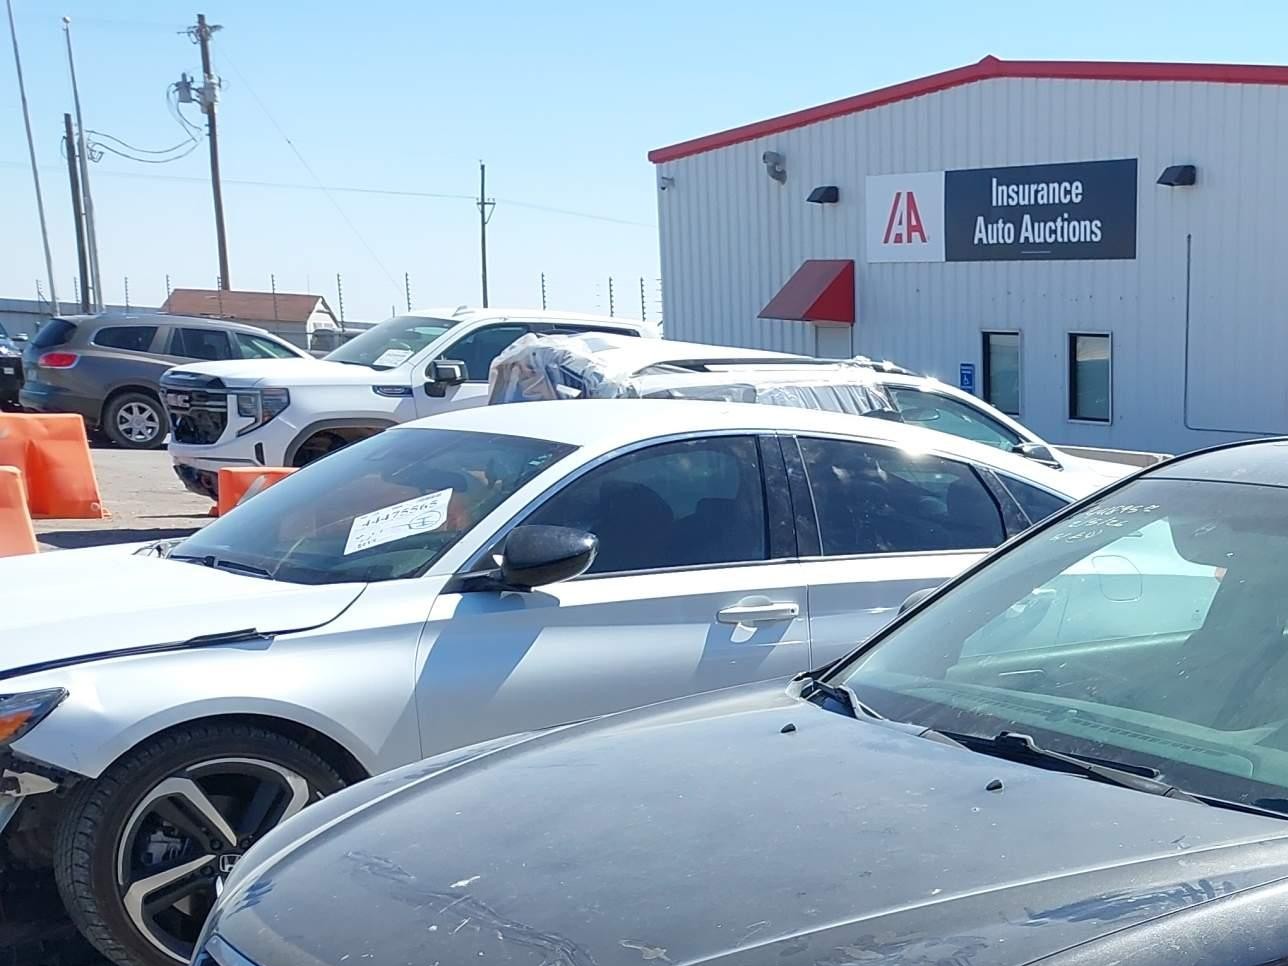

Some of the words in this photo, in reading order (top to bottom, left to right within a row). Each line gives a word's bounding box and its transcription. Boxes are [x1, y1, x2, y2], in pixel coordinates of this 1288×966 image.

[991, 178, 1083, 207] Insurance
[974, 216, 1015, 245] Auto
[1019, 213, 1102, 244] Auctions
